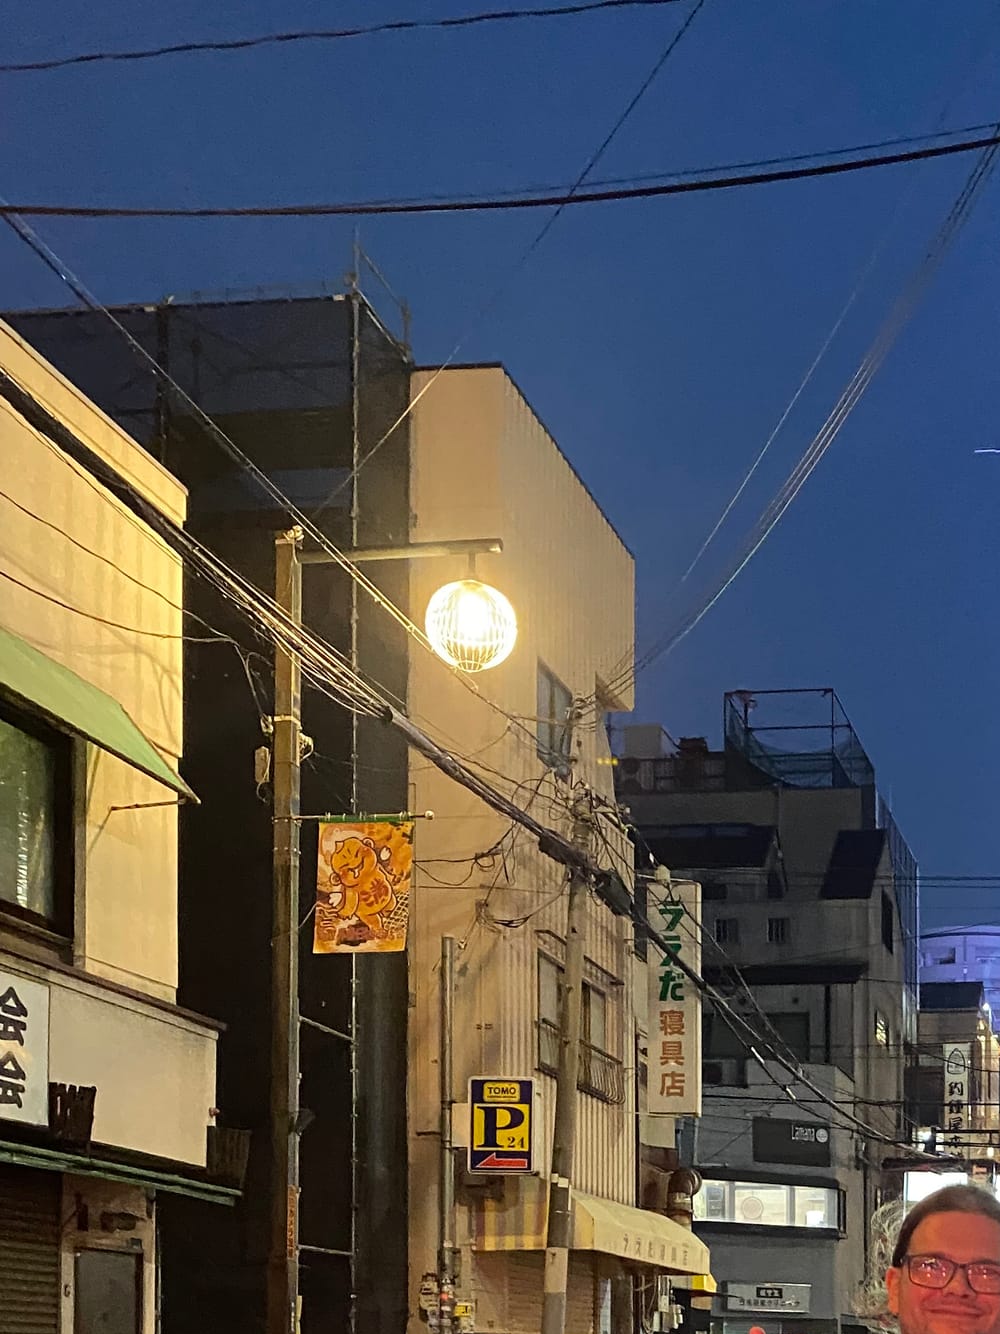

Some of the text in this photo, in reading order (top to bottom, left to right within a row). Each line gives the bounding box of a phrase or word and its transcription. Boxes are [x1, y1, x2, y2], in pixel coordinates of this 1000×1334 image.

[487, 1086, 516, 1095] TOMO
[476, 1105, 525, 1148] P
[507, 1136, 524, 1149] 24
